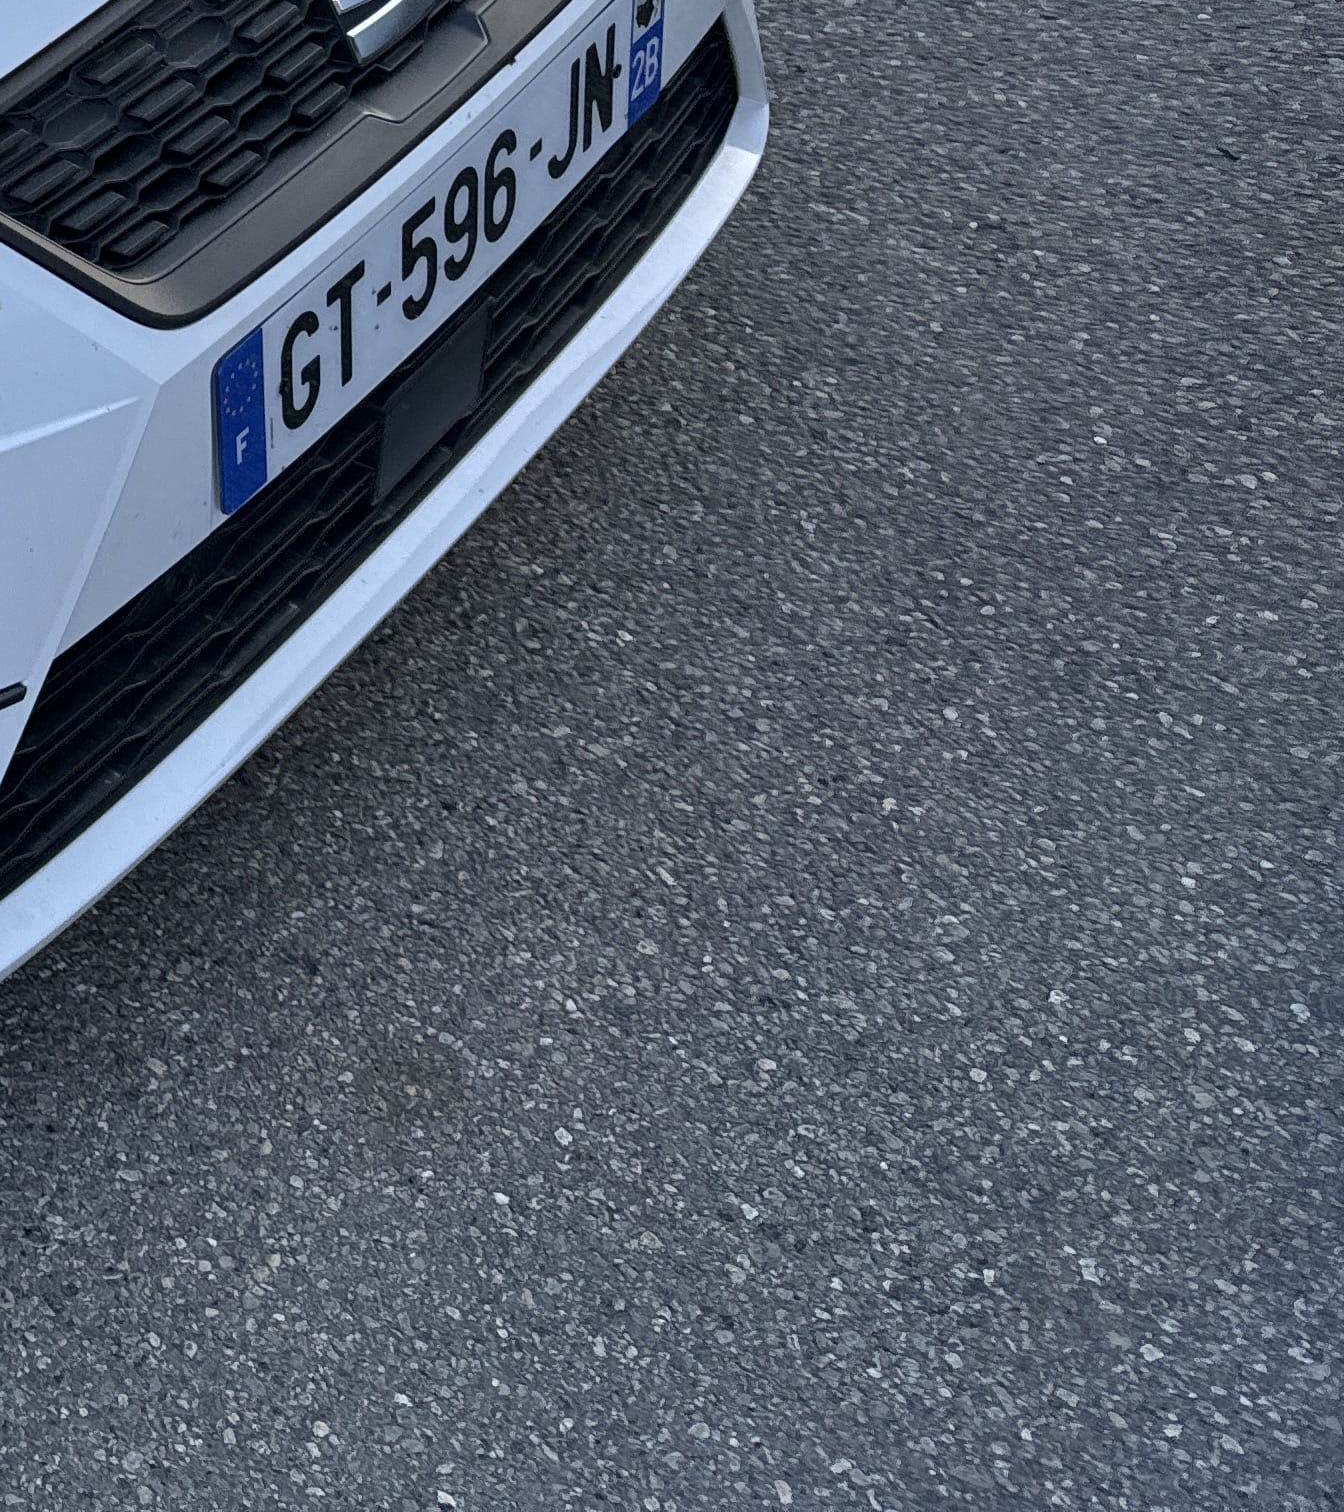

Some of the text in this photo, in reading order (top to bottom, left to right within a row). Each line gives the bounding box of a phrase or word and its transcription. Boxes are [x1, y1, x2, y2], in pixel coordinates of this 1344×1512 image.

[630, 37, 659, 102] 2B
[281, 23, 616, 430] GT-596-JN
[236, 426, 250, 465] F
